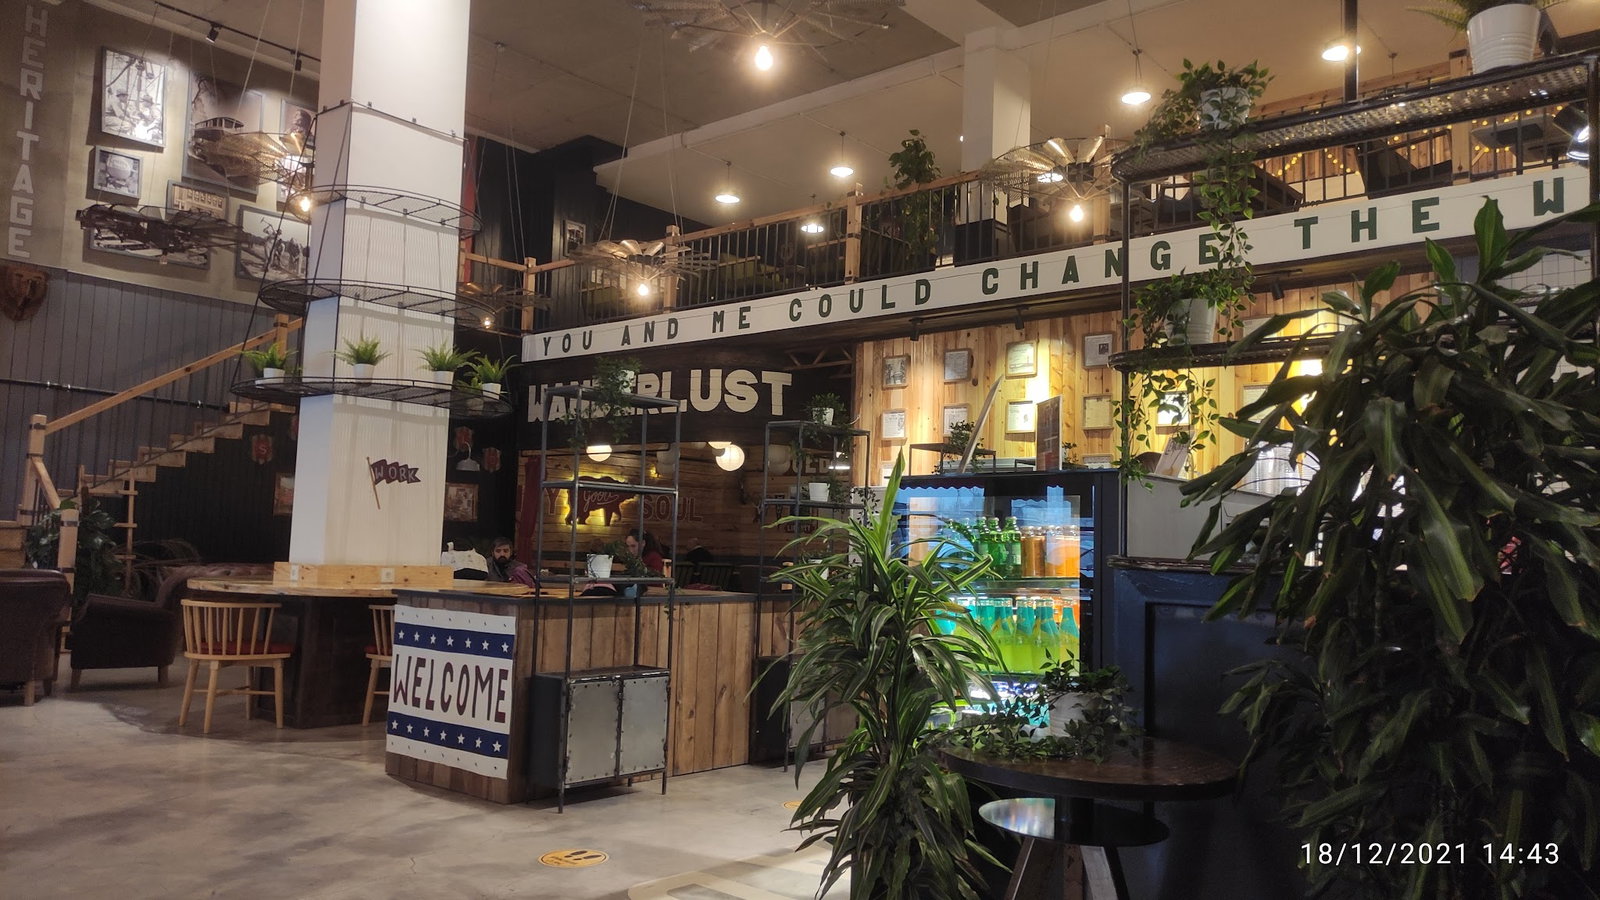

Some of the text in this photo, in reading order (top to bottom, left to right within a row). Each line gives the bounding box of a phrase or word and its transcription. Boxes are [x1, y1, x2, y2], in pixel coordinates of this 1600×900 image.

[8, 4, 49, 259] HERITAGE
[543, 330, 593, 357] YOU
[621, 317, 679, 347] AND
[711, 305, 752, 334] ME
[788, 278, 932, 322] COULD
[981, 232, 1219, 296] CHANGE
[1293, 196, 1440, 250] THE
[527, 368, 793, 423] WANDRLUST
[374, 465, 418, 482] WORK
[393, 653, 510, 724] WELCOME
